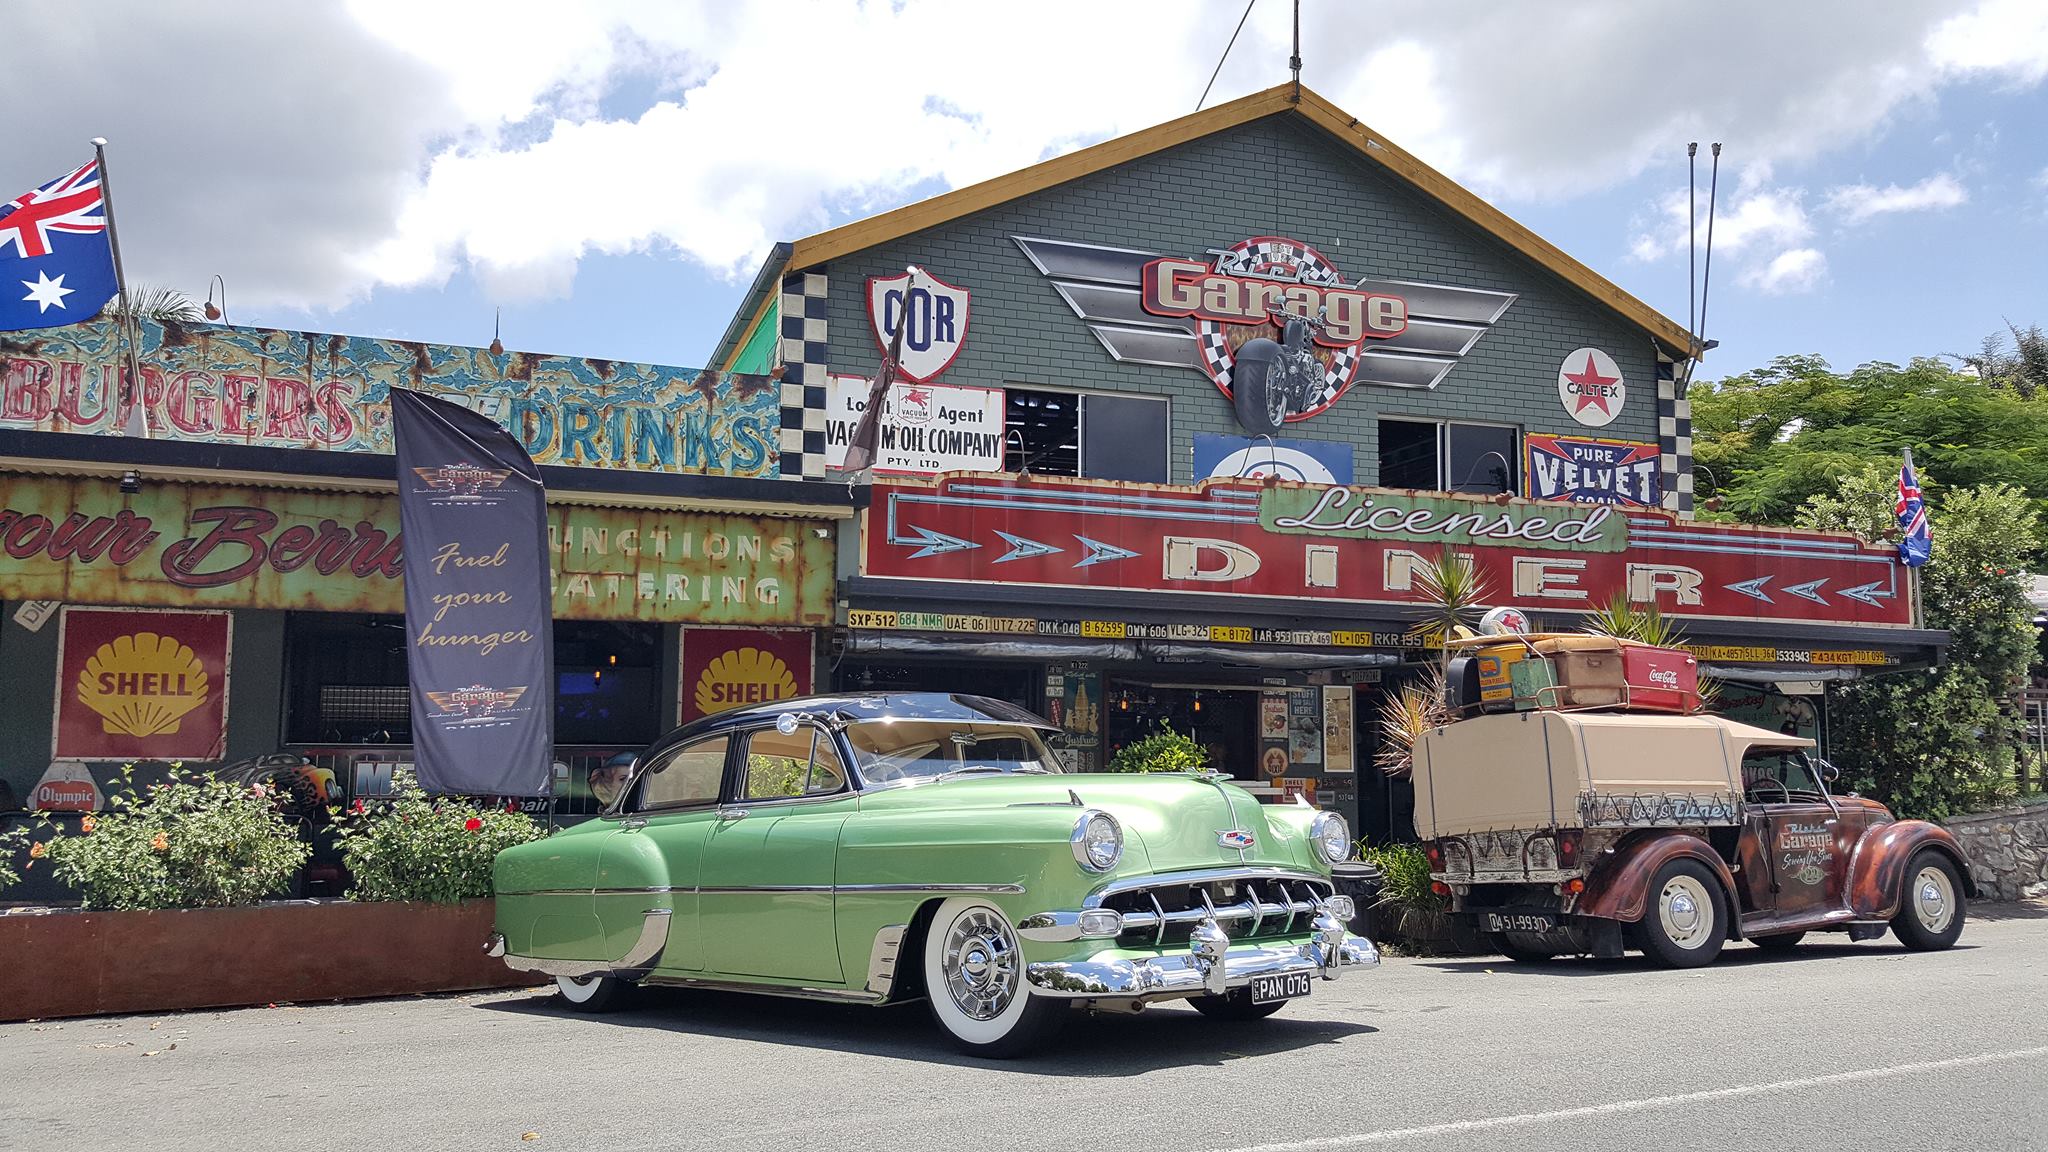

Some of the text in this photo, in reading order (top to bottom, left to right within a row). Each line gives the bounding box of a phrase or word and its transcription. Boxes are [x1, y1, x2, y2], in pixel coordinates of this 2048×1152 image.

[1157, 261, 1406, 341] Garage
[884, 287, 956, 352] COR
[2, 357, 358, 446] BURGERS
[1567, 382, 1619, 398] CALTEX
[938, 406, 984, 424] Agent
[509, 397, 767, 475] DRINKS
[900, 425, 925, 452] OIL
[929, 430, 1002, 459] COMPANY
[887, 457, 942, 469] PTY. LTD.
[1574, 447, 1614, 463] PURE
[439, 468, 492, 480] Garage
[1533, 451, 1654, 503] VELVET
[1275, 486, 1612, 544] Licensed
[0, 508, 161, 566] our
[549, 525, 796, 562] UNCTIONS
[431, 542, 510, 575] Fuel
[1162, 535, 1705, 606] DINER
[551, 572, 780, 605] ATERING
[432, 590, 512, 622] your
[417, 622, 533, 656] hunger
[97, 672, 193, 697] SHELL
[451, 690, 505, 702] Garage
[38, 787, 93, 805] Olympic
[1779, 832, 1833, 851] Garage
[1260, 974, 1309, 999] PAN 076
